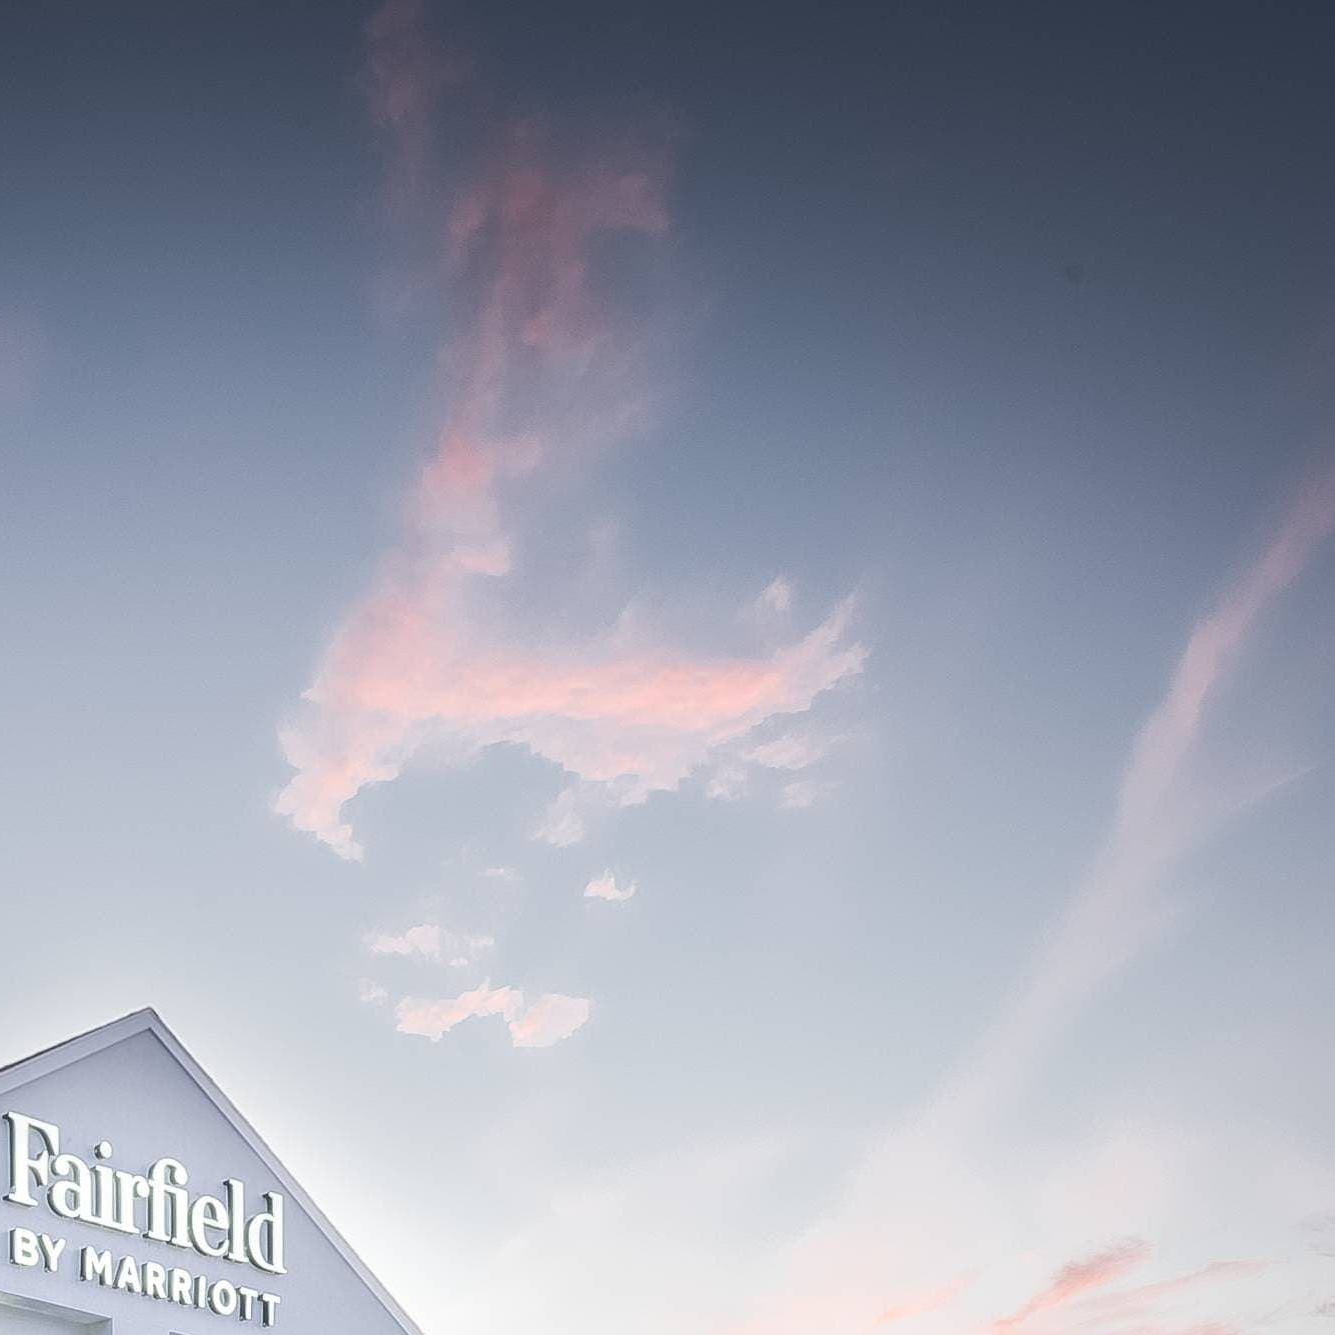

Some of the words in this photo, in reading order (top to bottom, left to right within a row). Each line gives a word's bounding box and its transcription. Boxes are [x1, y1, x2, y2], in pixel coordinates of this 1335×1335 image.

[3, 1111, 287, 1274] Fairfield
[9, 1226, 66, 1273] BY
[80, 1245, 281, 1328] MARRIOTT
